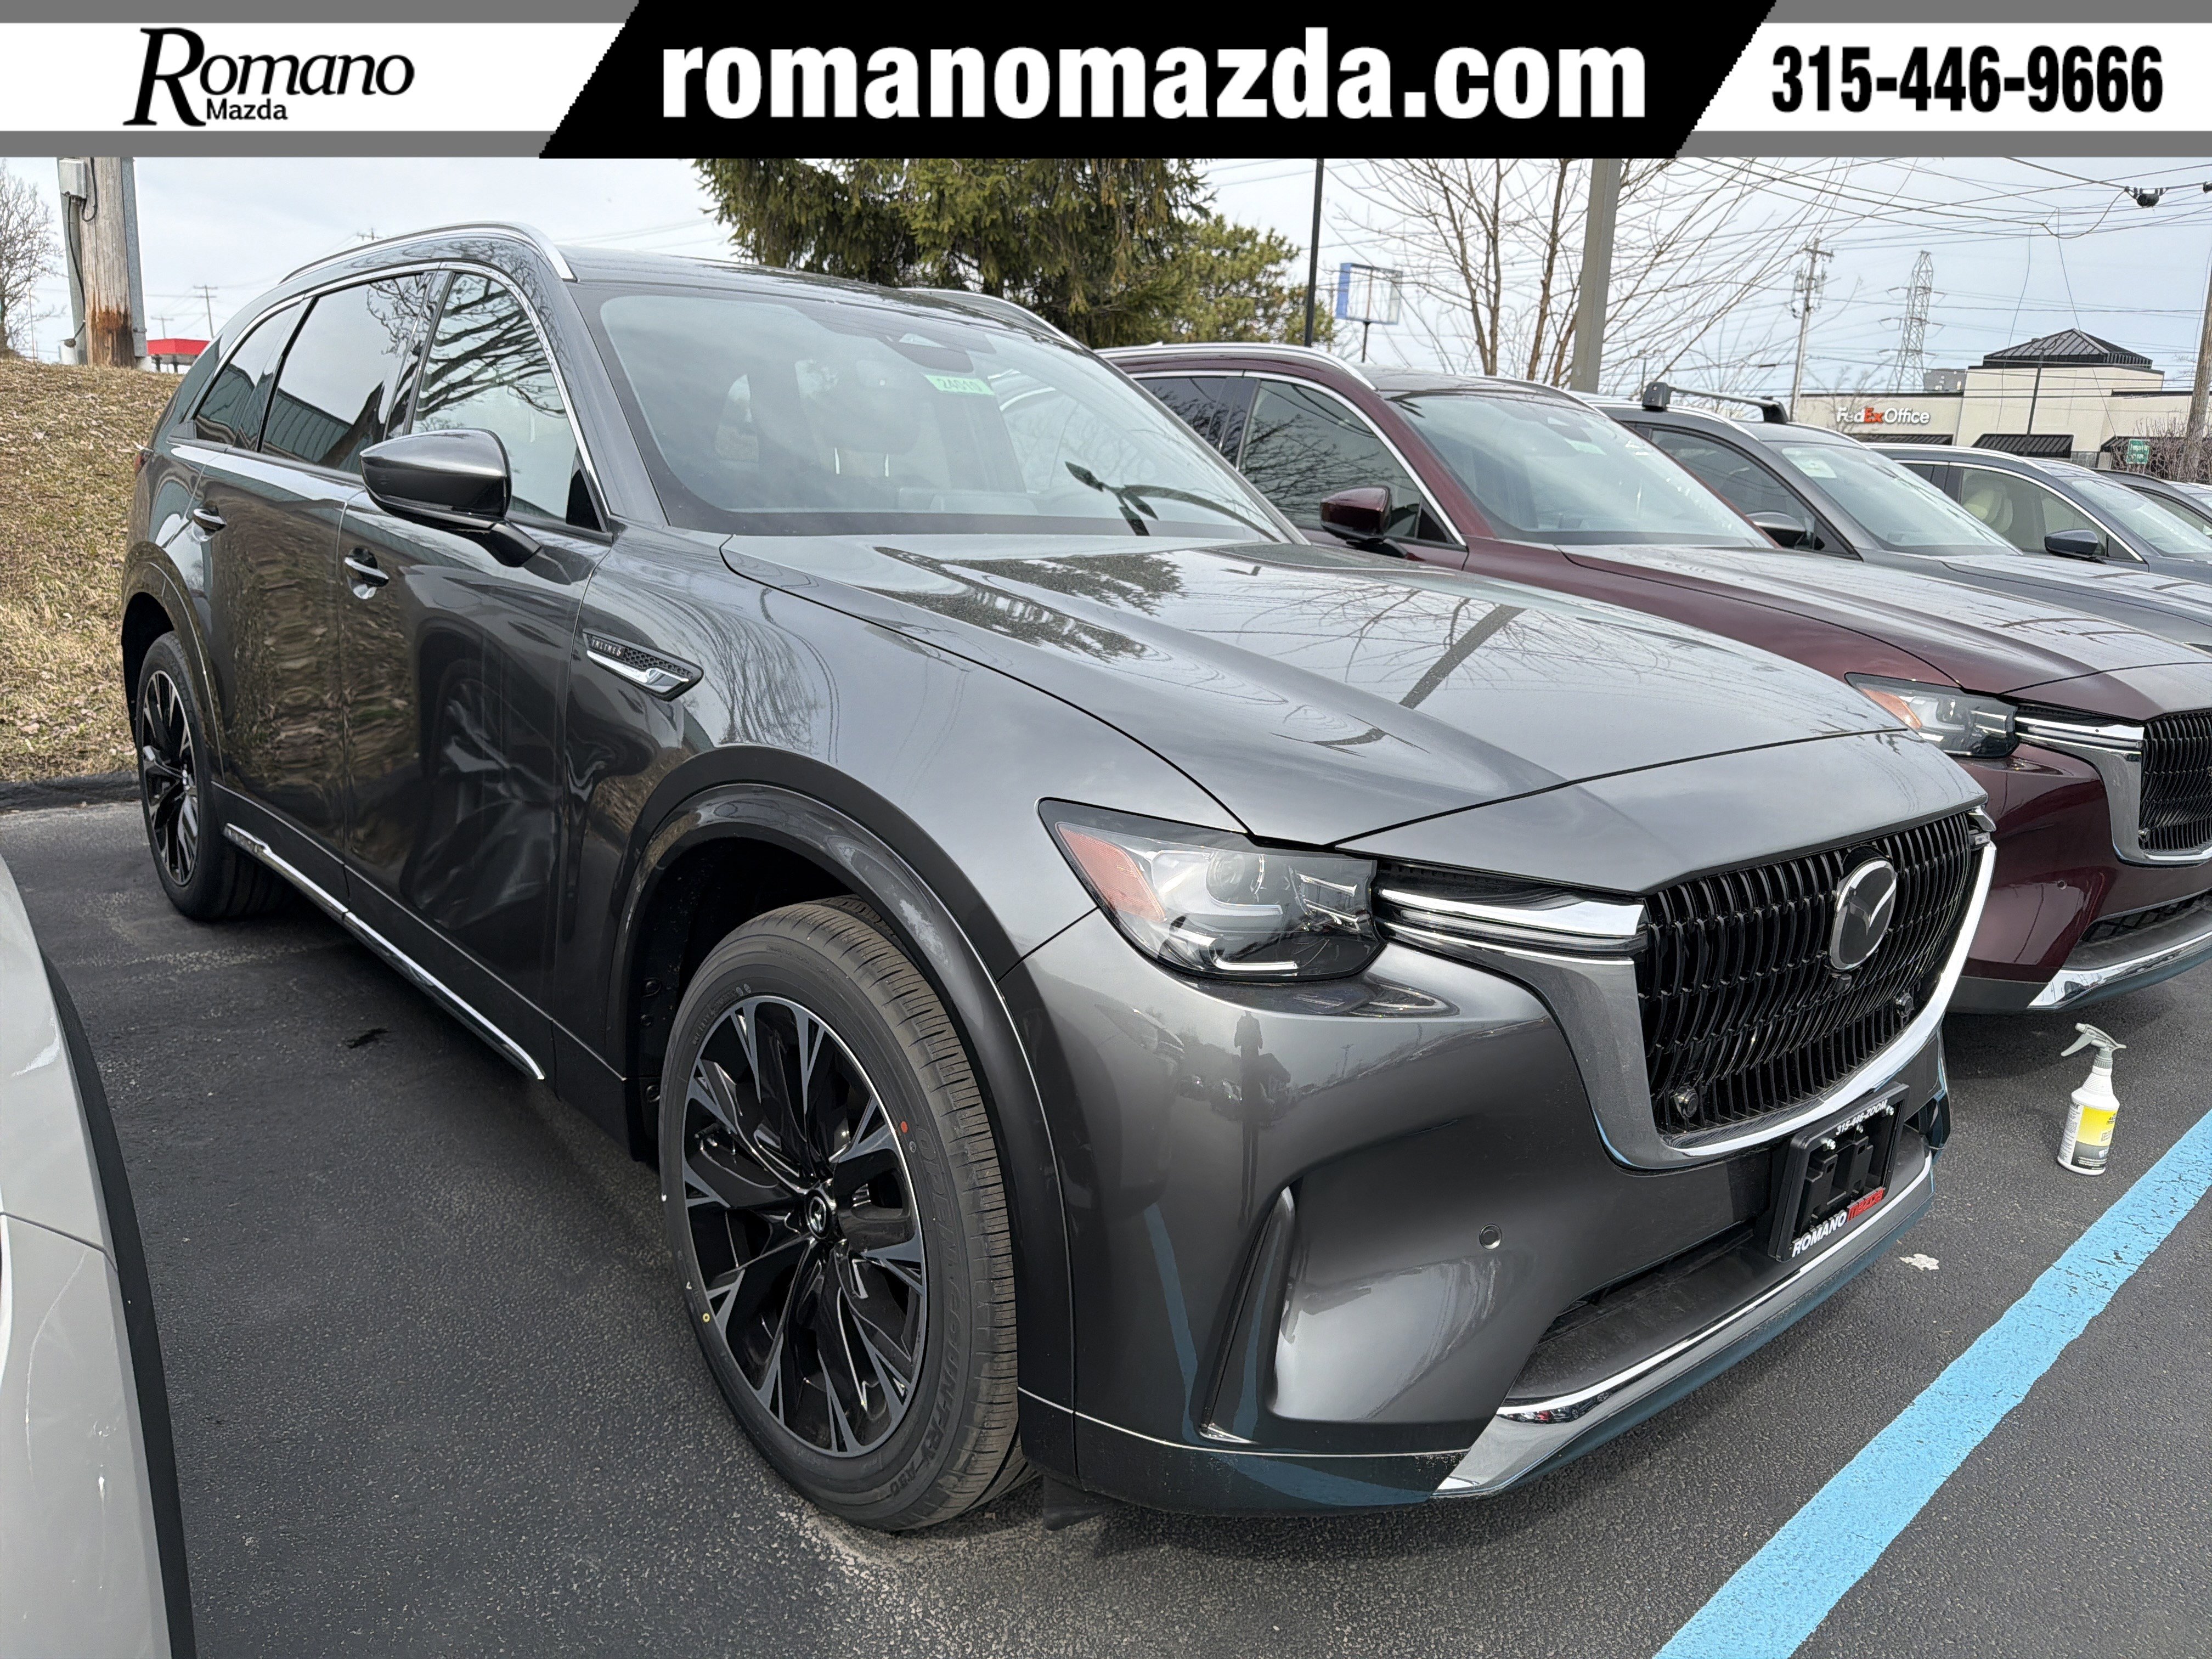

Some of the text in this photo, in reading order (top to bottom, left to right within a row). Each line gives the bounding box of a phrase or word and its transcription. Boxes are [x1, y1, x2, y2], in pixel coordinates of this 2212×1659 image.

[1837, 407, 1929, 424] FedEx Office
[1836, 1099, 1888, 1136] 315-446-ZOOM
[1792, 1211, 1847, 1257] ROMANO
